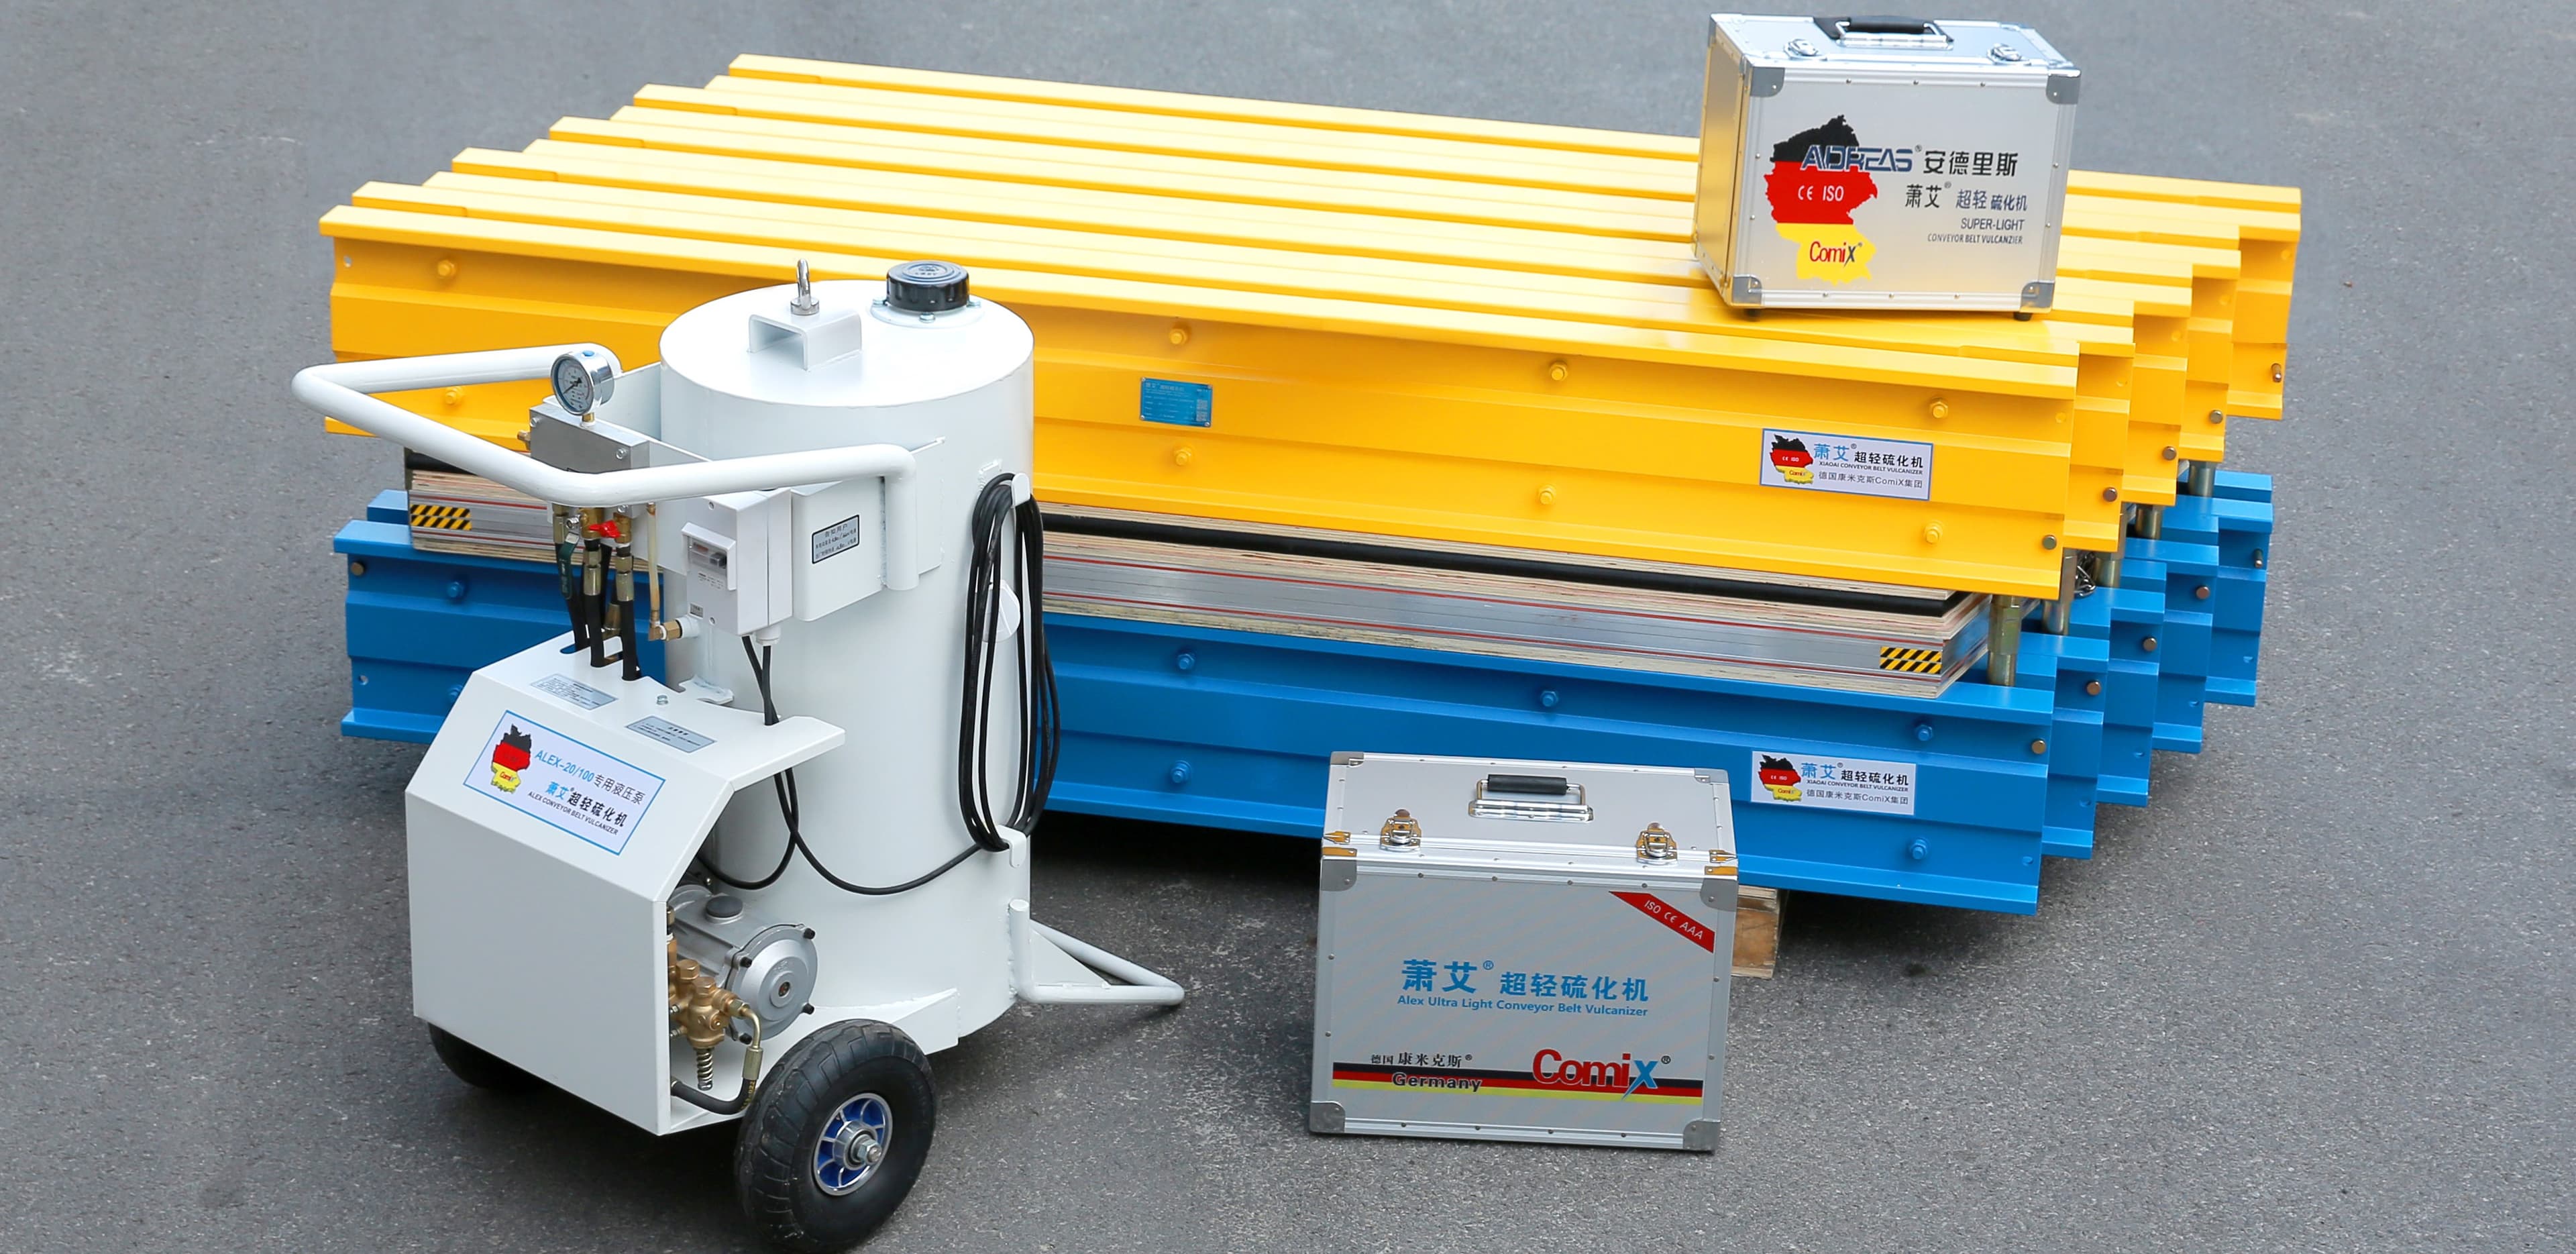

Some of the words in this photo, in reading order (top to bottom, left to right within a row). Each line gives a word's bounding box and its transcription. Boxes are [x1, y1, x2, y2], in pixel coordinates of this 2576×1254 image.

[1923, 150, 2018, 176] 安德里斯
[1823, 185, 1844, 201] ISO
[1905, 184, 1942, 208] 萧艾
[1961, 217, 2025, 231] SUPER-LIGHT
[1927, 233, 1964, 242] CONVEYOR
[1965, 234, 1980, 244] BELT
[1814, 443, 1849, 462] 萧艾
[1854, 451, 1923, 468] 超轻硫化机
[1840, 462, 1872, 470] CONVEYOR
[1887, 467, 1923, 475] VULCANIZER
[1801, 762, 1836, 780] 萧艾
[1841, 770, 1909, 786] 超轻硫化机
[1827, 780, 1858, 788] CONVEYOR
[527, 791, 542, 802] ALEX
[542, 797, 571, 815] CONVEYOR
[571, 810, 586, 821] BELT
[585, 816, 619, 835] VULCANIZER
[567, 791, 628, 827] 超轻硫化机
[1644, 900, 1661, 914] ISO
[1679, 921, 1703, 940] AAA
[1401, 959, 1477, 994] 萧艾
[1500, 972, 1648, 1002] 超轻硫化机
[1397, 995, 1424, 1006] Alex
[1428, 996, 1458, 1008] Ultra
[1462, 998, 1493, 1010] Light
[1497, 1000, 1554, 1014] Conveyor
[1558, 1003, 1582, 1014] Belt
[1586, 1004, 1648, 1016] Vulcanizer
[1392, 1072, 1482, 1092] Germany
